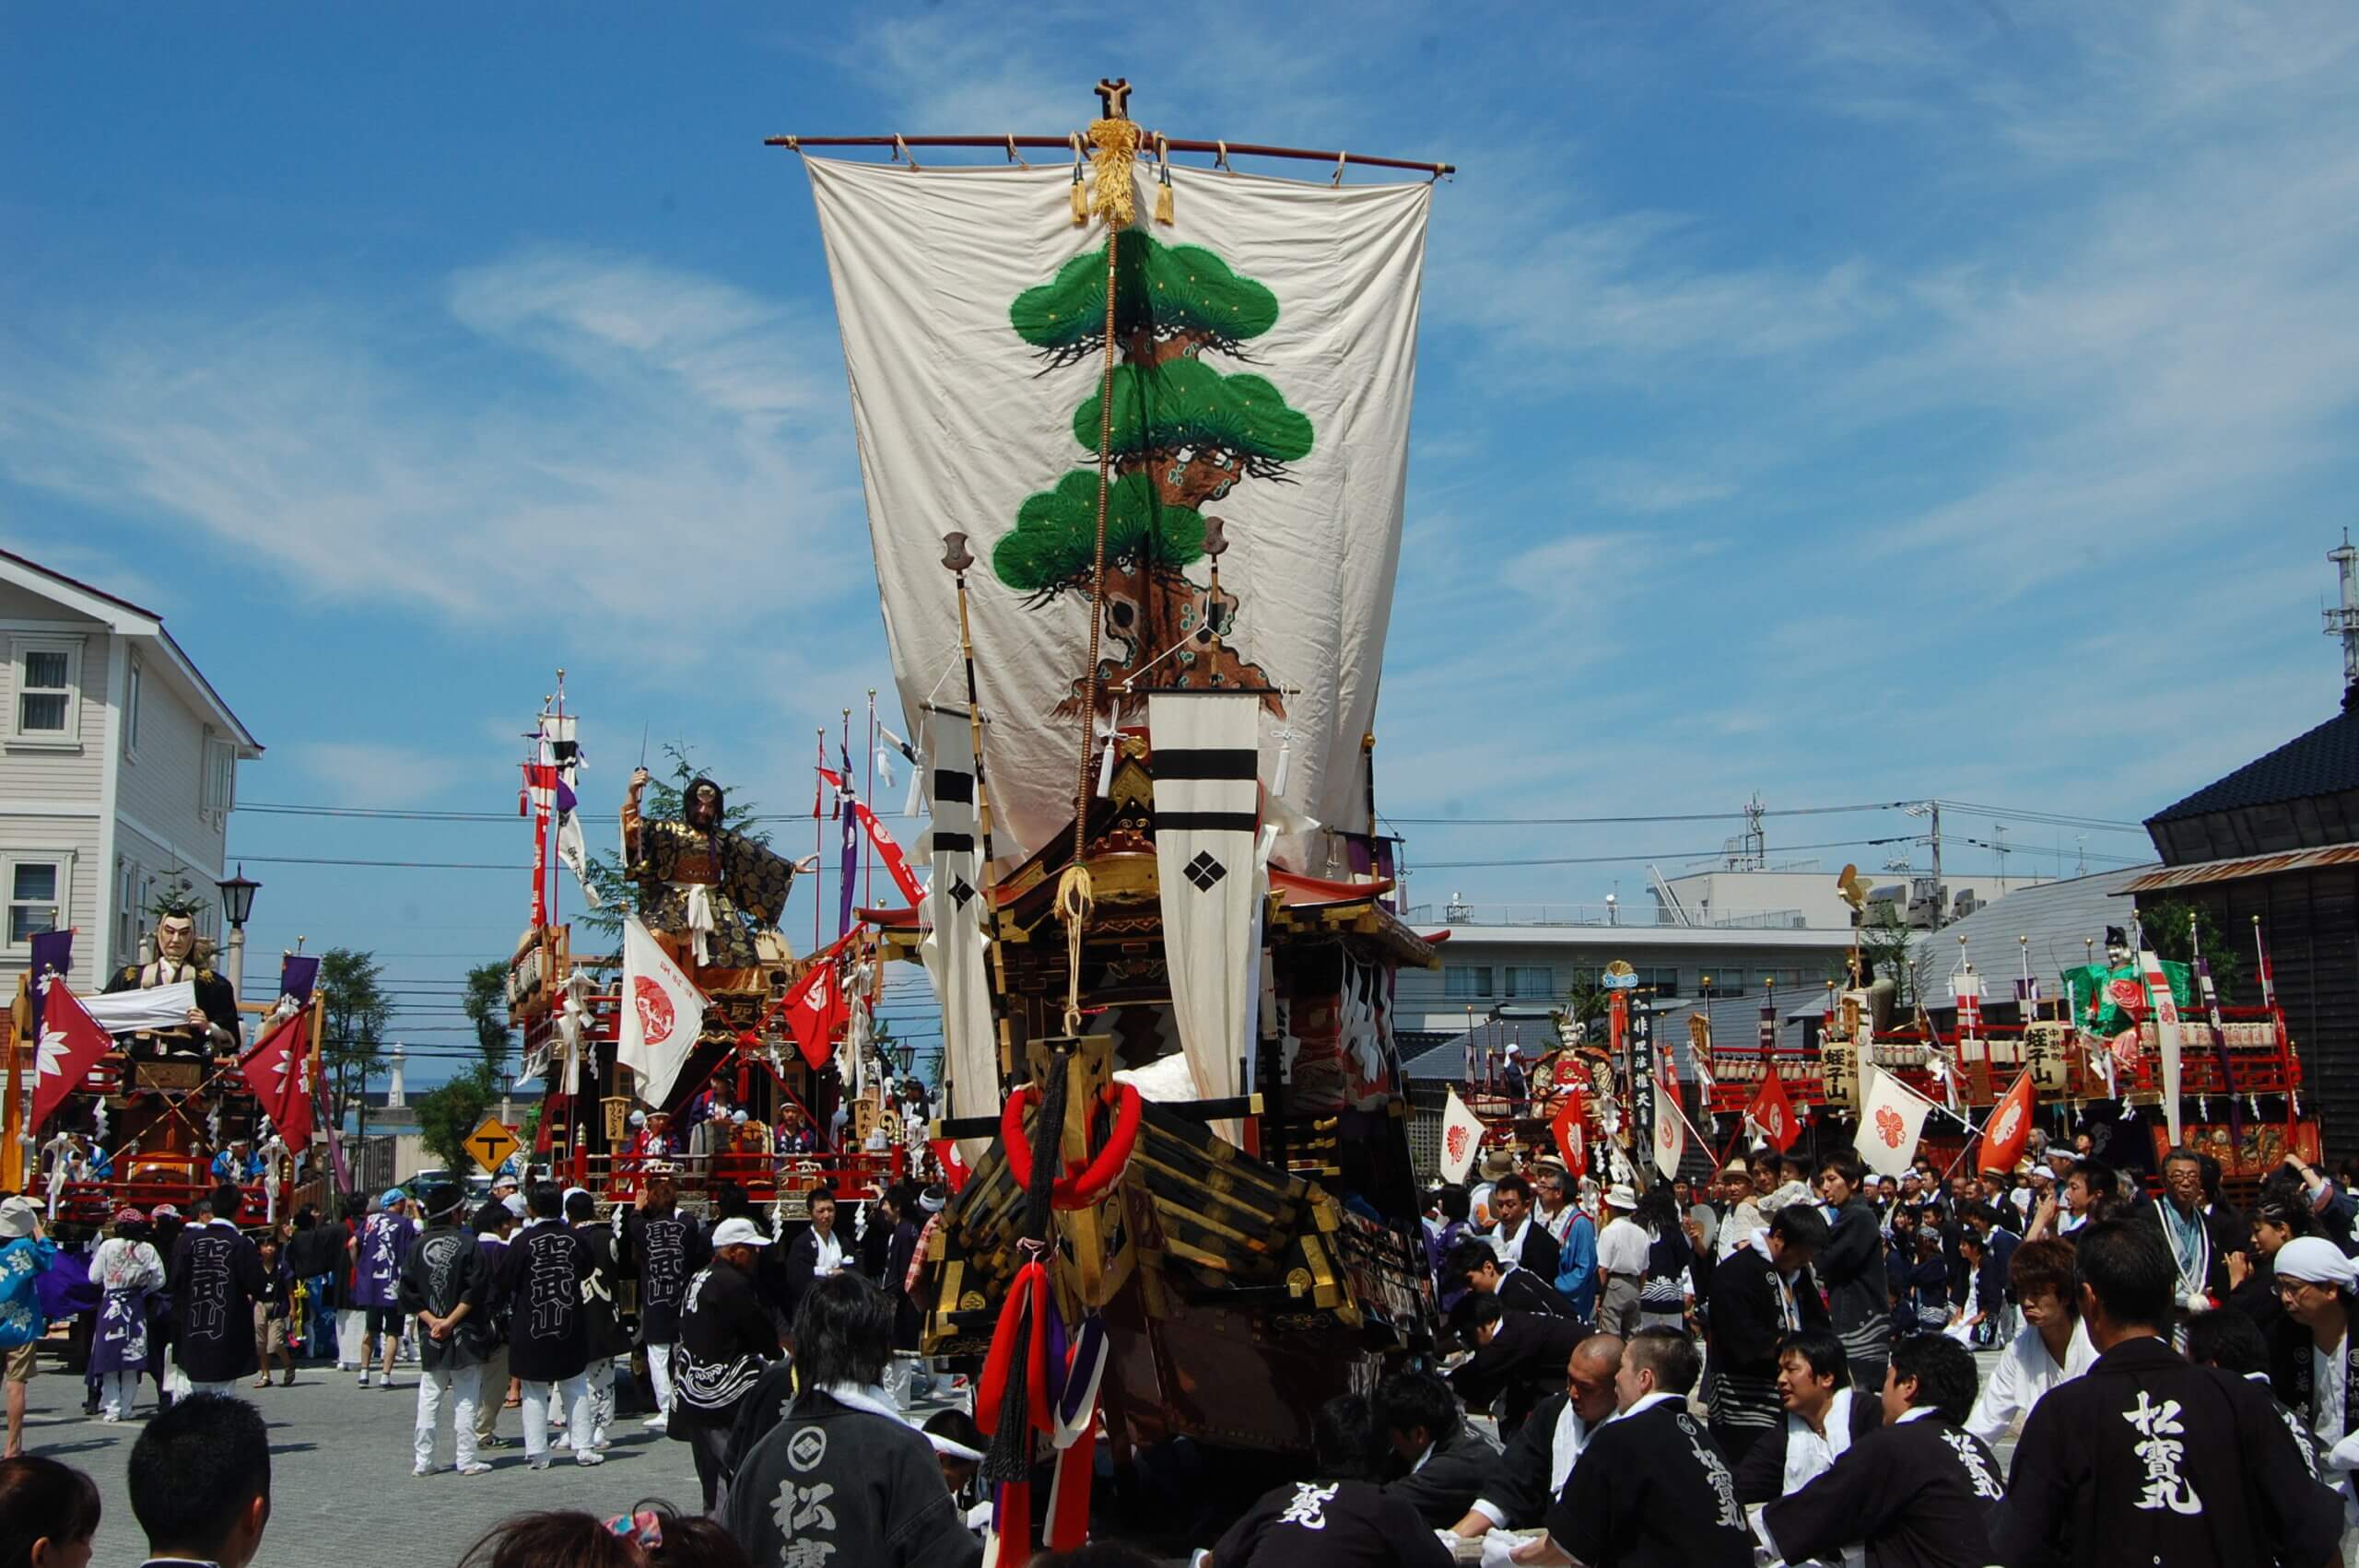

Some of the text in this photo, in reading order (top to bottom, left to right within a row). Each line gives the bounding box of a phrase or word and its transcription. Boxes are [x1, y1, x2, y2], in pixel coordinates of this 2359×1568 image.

[1825, 1048, 1848, 1101] 蛭子山
[2026, 1027, 2053, 1084] 蛭子山
[191, 1237, 232, 1340] 聖武山
[530, 1233, 577, 1340] 聖武山
[646, 1220, 687, 1307] 聖武山
[2121, 1390, 2202, 1515] 松寶丸
